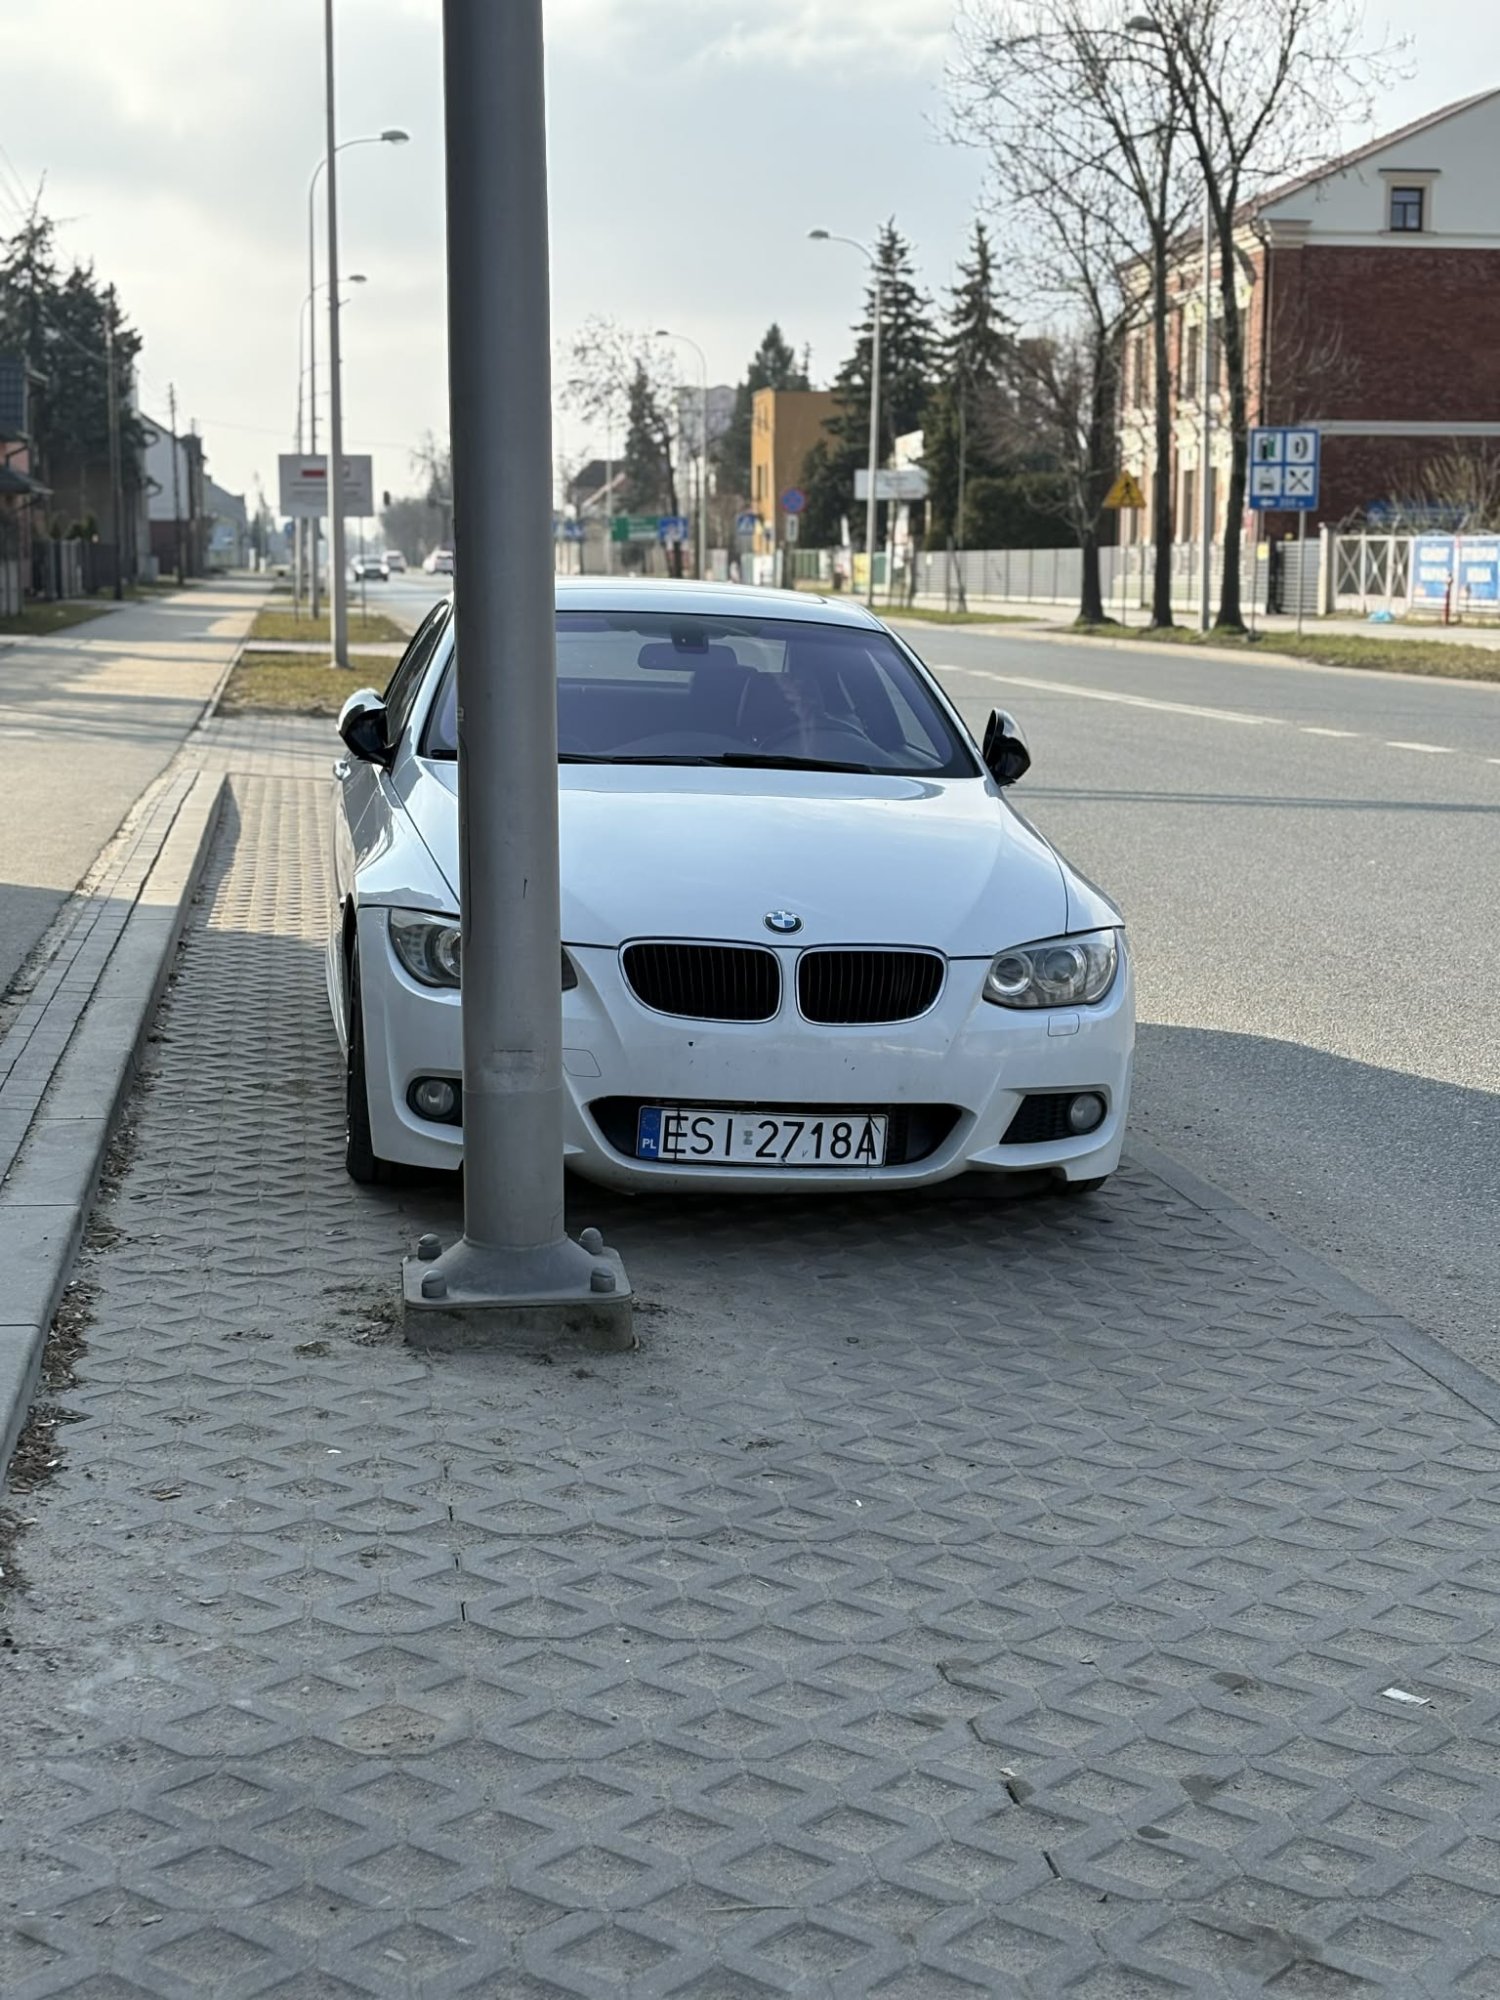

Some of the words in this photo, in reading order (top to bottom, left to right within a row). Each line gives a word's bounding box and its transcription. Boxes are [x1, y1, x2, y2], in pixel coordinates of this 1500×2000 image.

[641, 1137, 657, 1150] PL
[661, 1115, 733, 1156] ESI
[755, 1120, 877, 1160] 2718A
